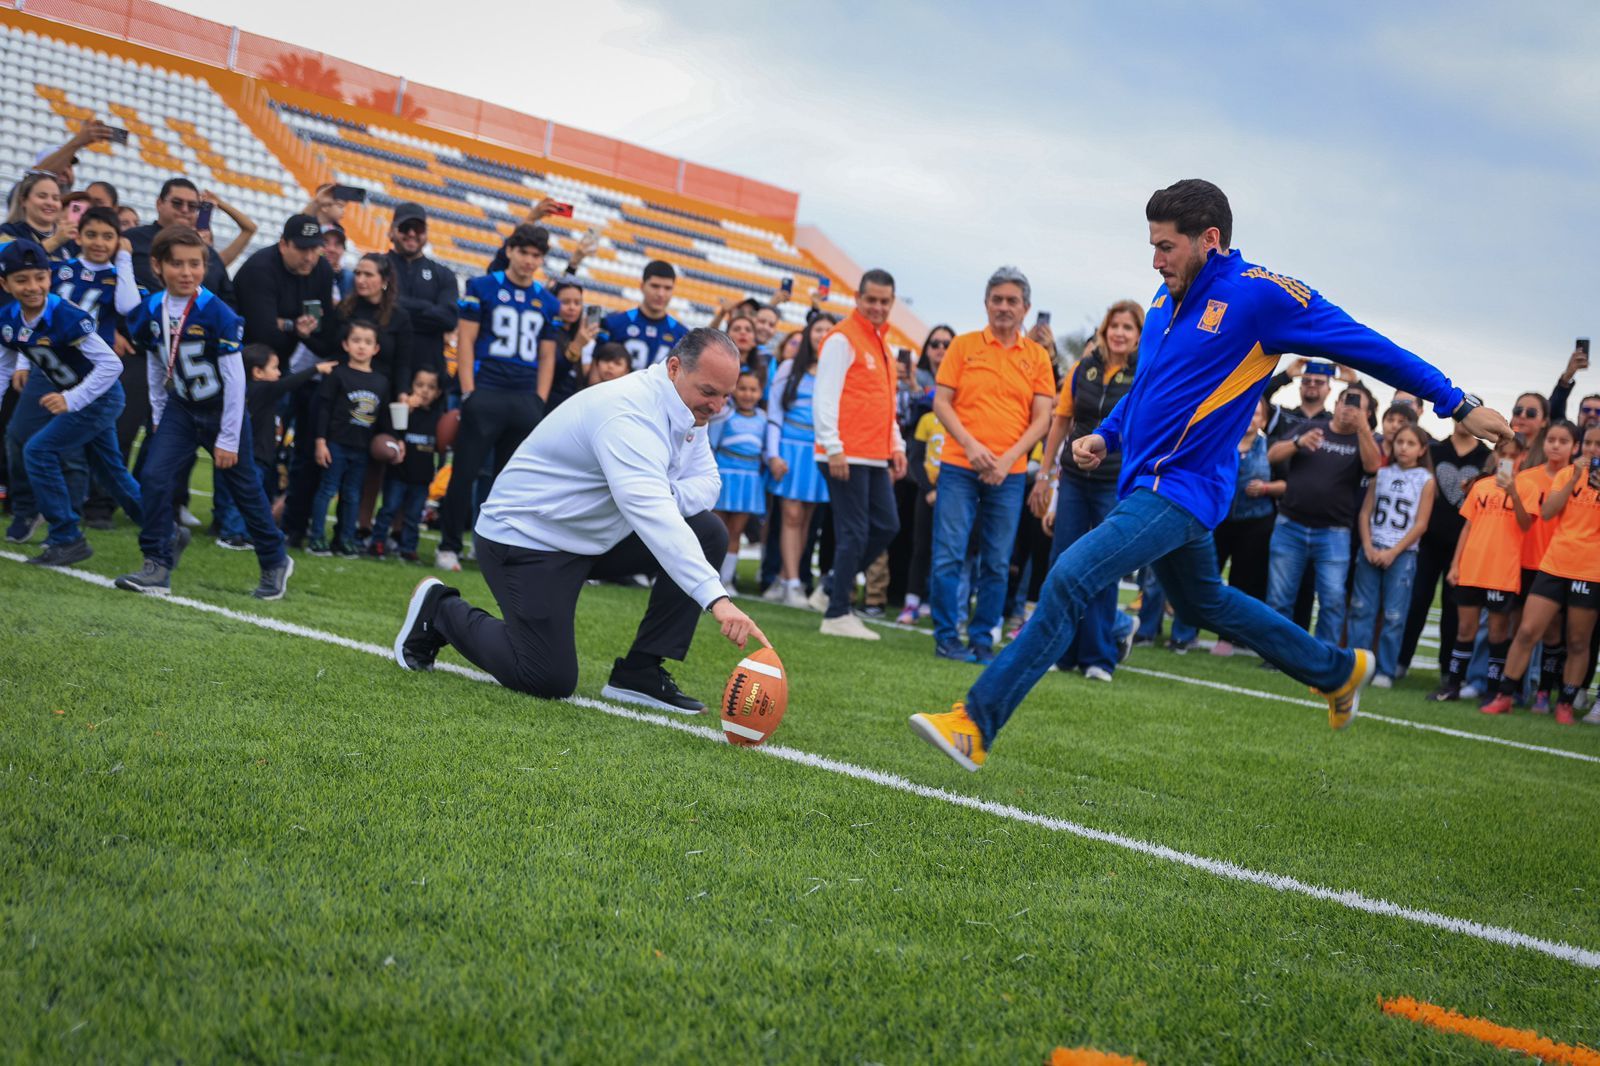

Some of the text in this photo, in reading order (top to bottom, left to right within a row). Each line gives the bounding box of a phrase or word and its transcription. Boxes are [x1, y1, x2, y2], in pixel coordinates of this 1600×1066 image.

[488, 305, 544, 362] 98
[158, 340, 221, 401] 15
[1374, 495, 1413, 530] 65
[1487, 590, 1504, 602] NL
[1571, 580, 1590, 594] NL
[742, 682, 760, 716] Wilson
[759, 691, 770, 716] GST
